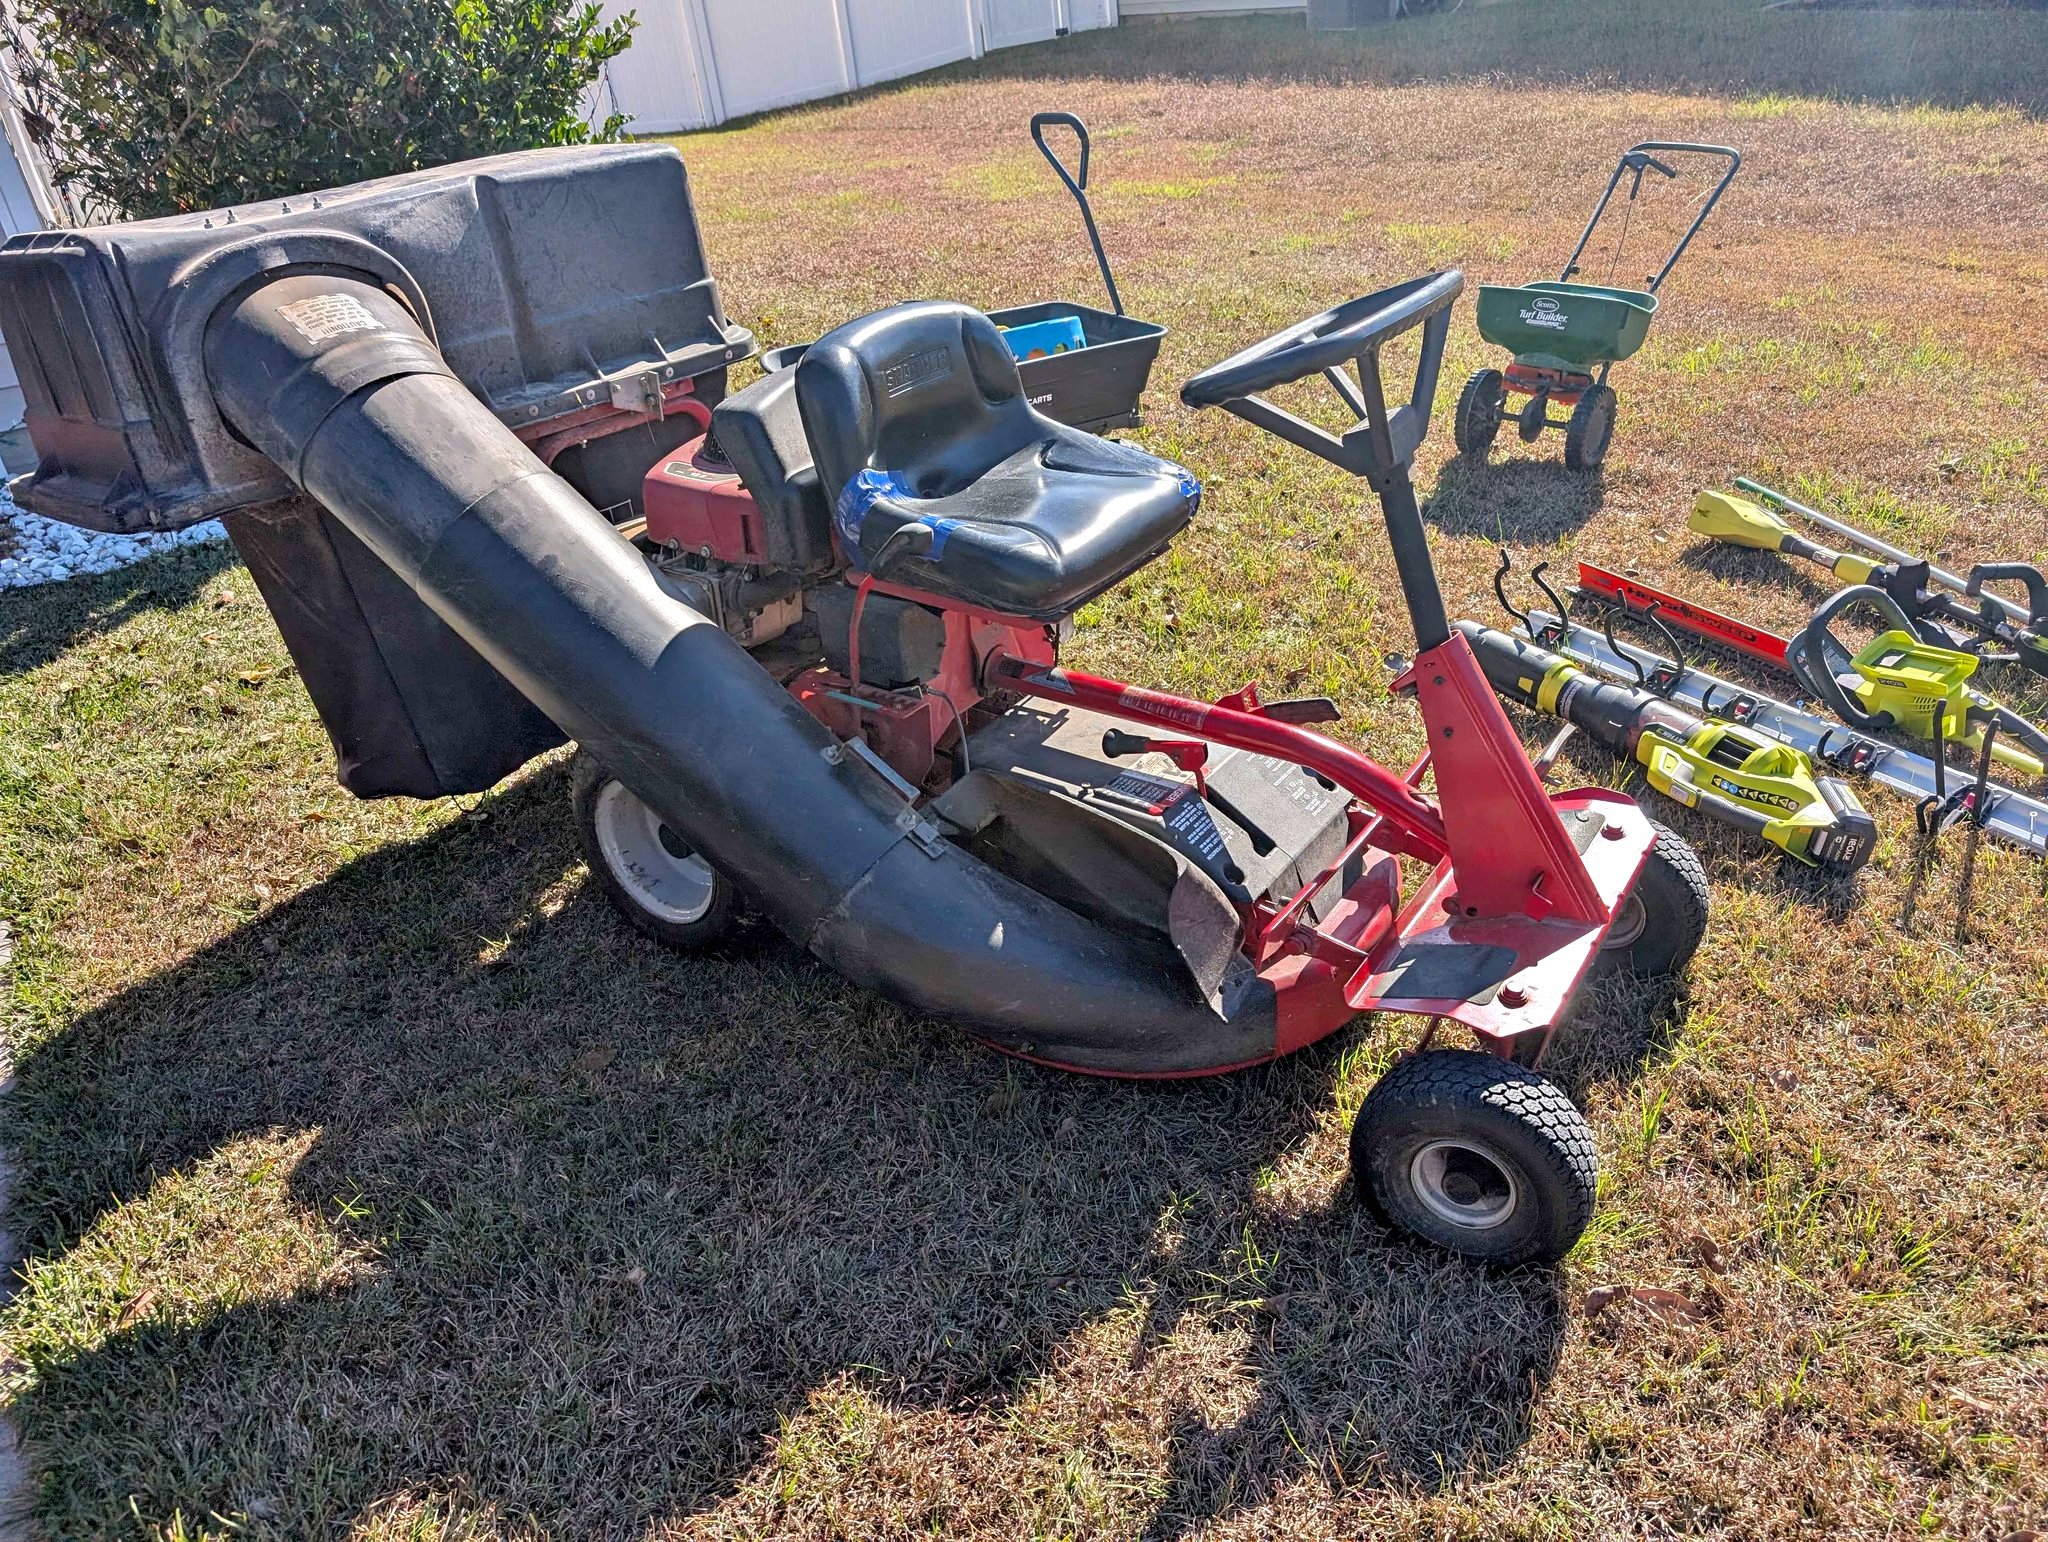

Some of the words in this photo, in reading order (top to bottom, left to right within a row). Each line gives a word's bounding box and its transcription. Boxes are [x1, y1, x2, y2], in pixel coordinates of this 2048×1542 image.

[1536, 301, 1556, 309] Scotts
[1520, 309, 1536, 318] Turf
[1536, 312, 1568, 322] Builder
[320, 320, 366, 334] CAUTION!!!
[1879, 678, 1905, 687] RYOBI
[1188, 813, 1198, 822] STOP
[1178, 820, 1190, 831] BLADE
[1842, 838, 1857, 860] RYOBI
